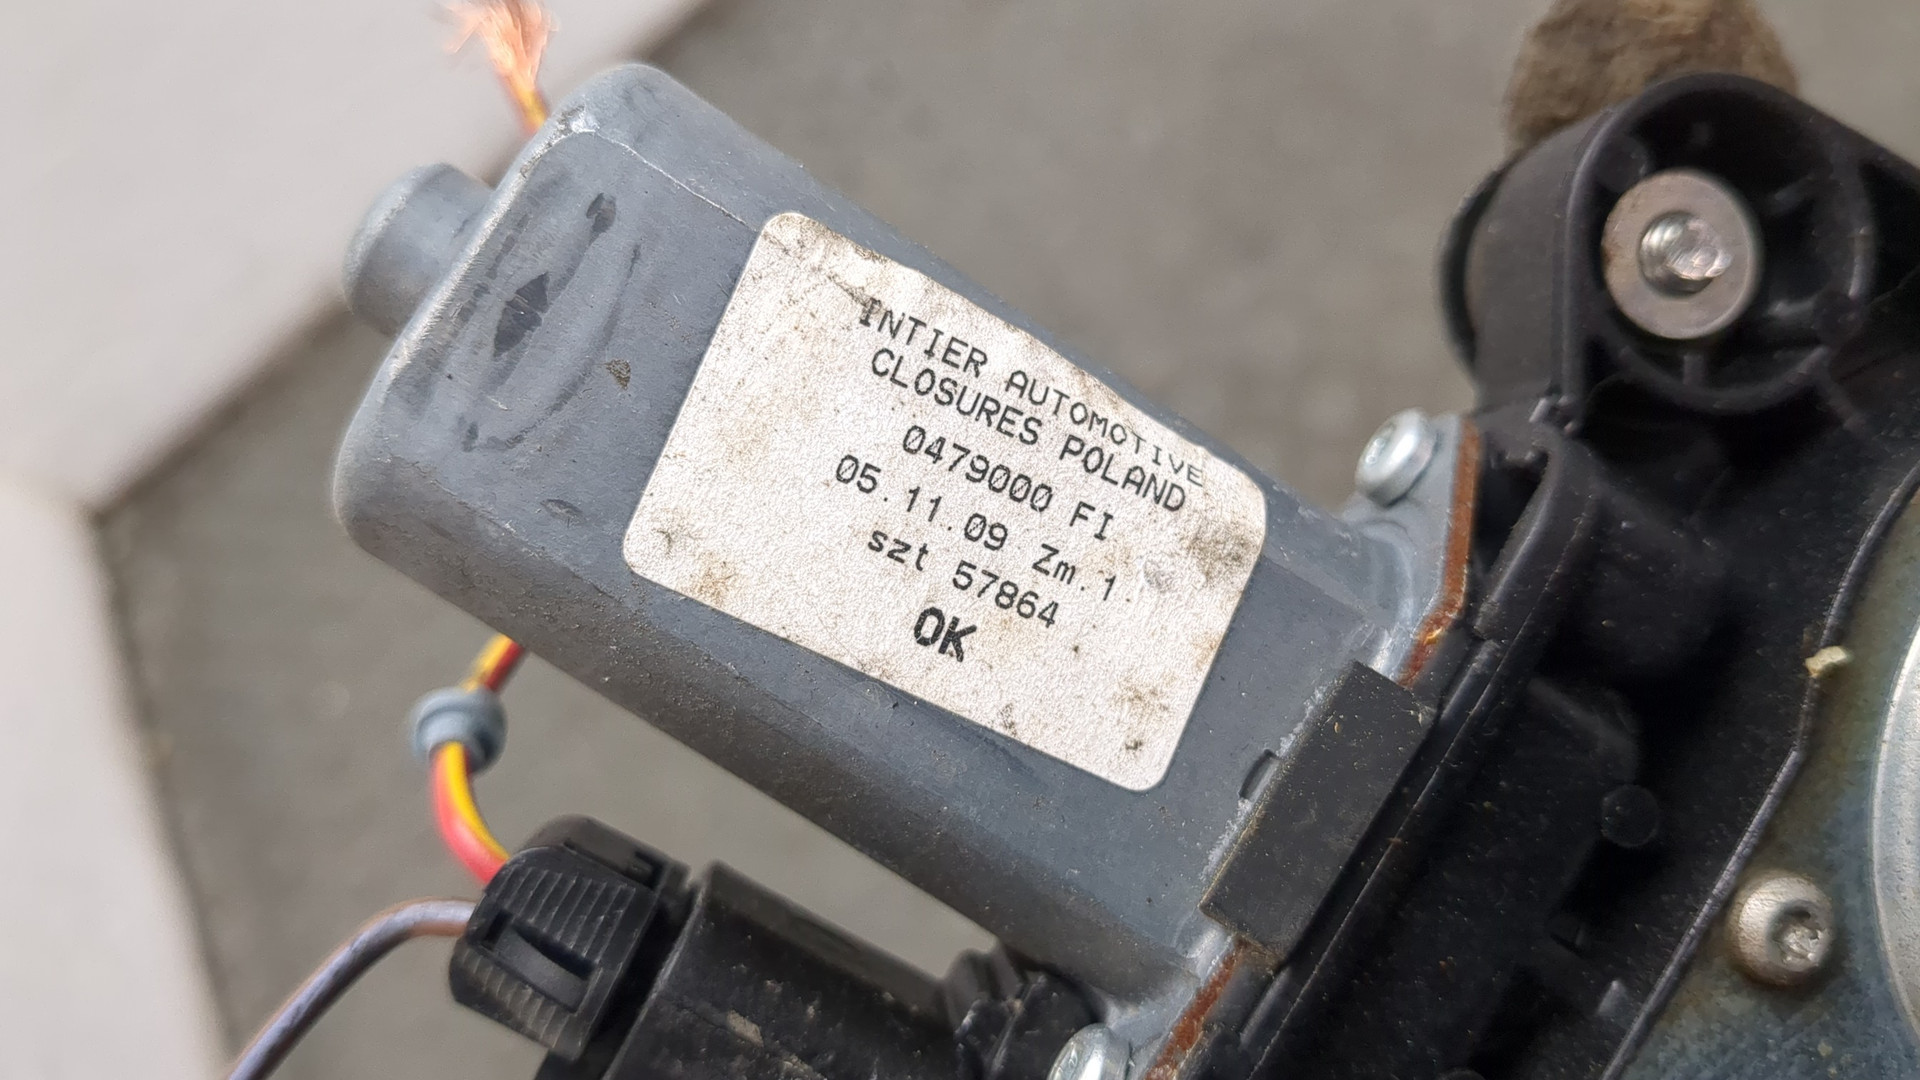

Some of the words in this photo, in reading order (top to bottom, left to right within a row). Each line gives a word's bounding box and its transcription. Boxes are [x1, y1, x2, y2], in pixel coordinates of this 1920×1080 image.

[858, 299, 988, 378] INTIER
[1004, 369, 1205, 488] AUTOMOTIVE
[871, 347, 1043, 446] CLOSURES
[1059, 434, 1187, 513] POLAND
[835, 454, 1009, 551] 05.11.09
[902, 425, 1054, 513] 0479000
[1069, 501, 1115, 542] FI
[867, 530, 929, 572] szt
[952, 560, 1060, 629] 57864
[913, 606, 978, 663] OK
